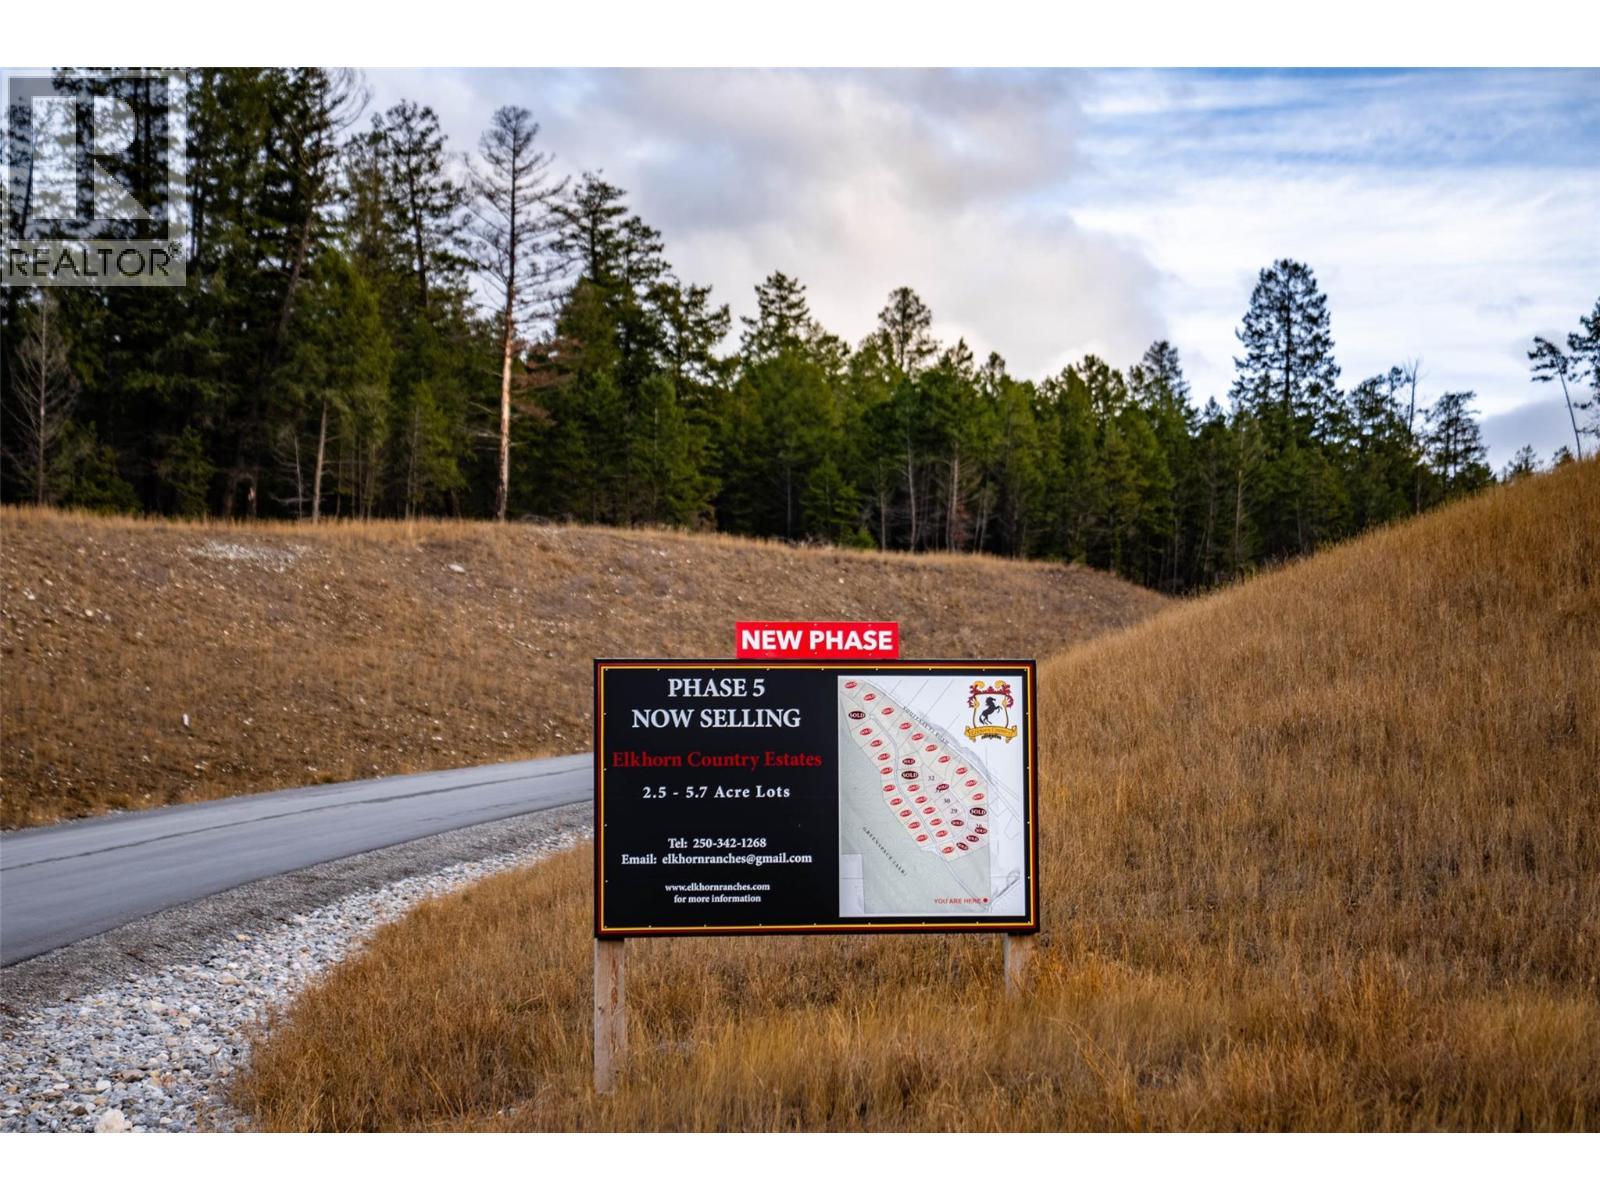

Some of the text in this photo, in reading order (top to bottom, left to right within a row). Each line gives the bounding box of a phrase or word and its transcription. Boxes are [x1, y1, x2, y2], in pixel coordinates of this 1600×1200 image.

[741, 629, 893, 651] NEW PHASE
[667, 677, 766, 698] PHASE 5
[631, 708, 801, 729] NOW SELLING
[612, 751, 823, 772] Elkhorn Country Estates
[643, 786, 667, 799] 2.5
[686, 785, 708, 799] 5.7
[714, 785, 750, 799] Acre
[756, 785, 791, 799] Lots
[668, 837, 767, 849] Tel: 250-342-1268
[621, 852, 813, 867] Email: elkhornranches@gmail.com
[664, 882, 771, 892] www.elkhornranches.com
[673, 893, 762, 904] for more information
